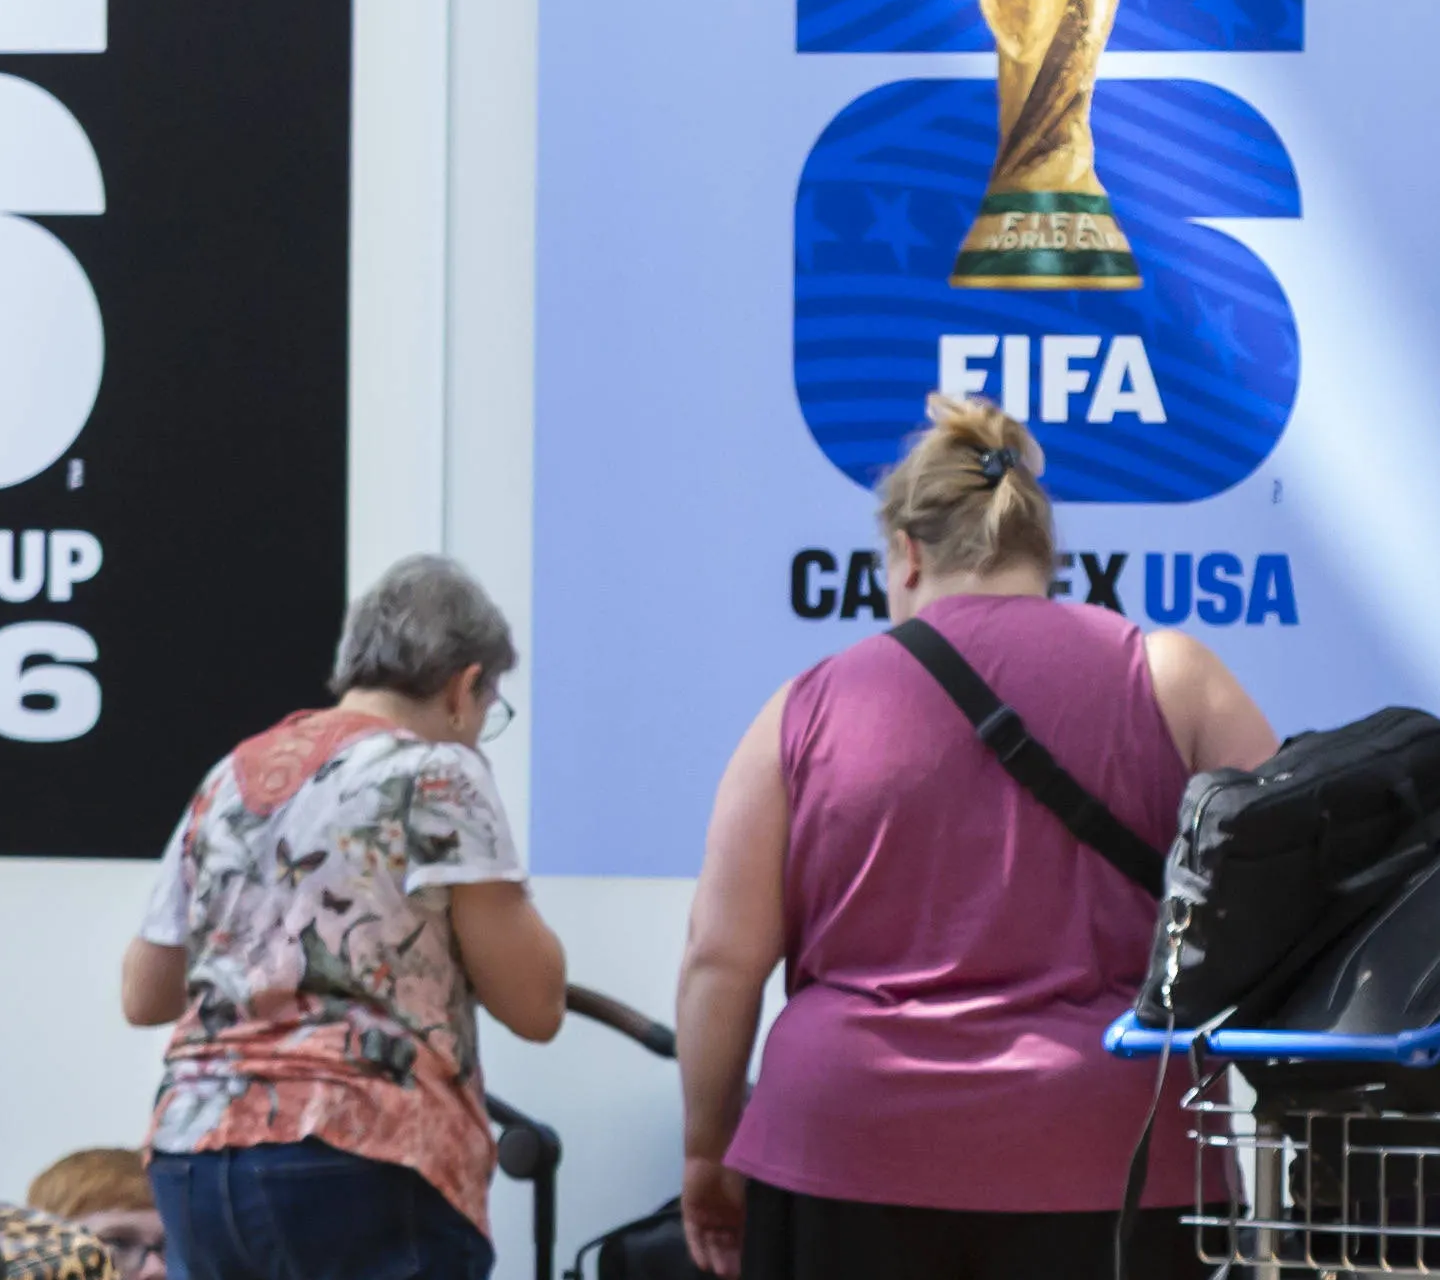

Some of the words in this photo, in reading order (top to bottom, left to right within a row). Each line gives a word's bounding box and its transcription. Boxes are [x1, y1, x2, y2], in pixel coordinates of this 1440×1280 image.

[1003, 212, 1097, 231] FIFA
[938, 334, 1167, 424] FIFA
[1144, 551, 1300, 627] USA
